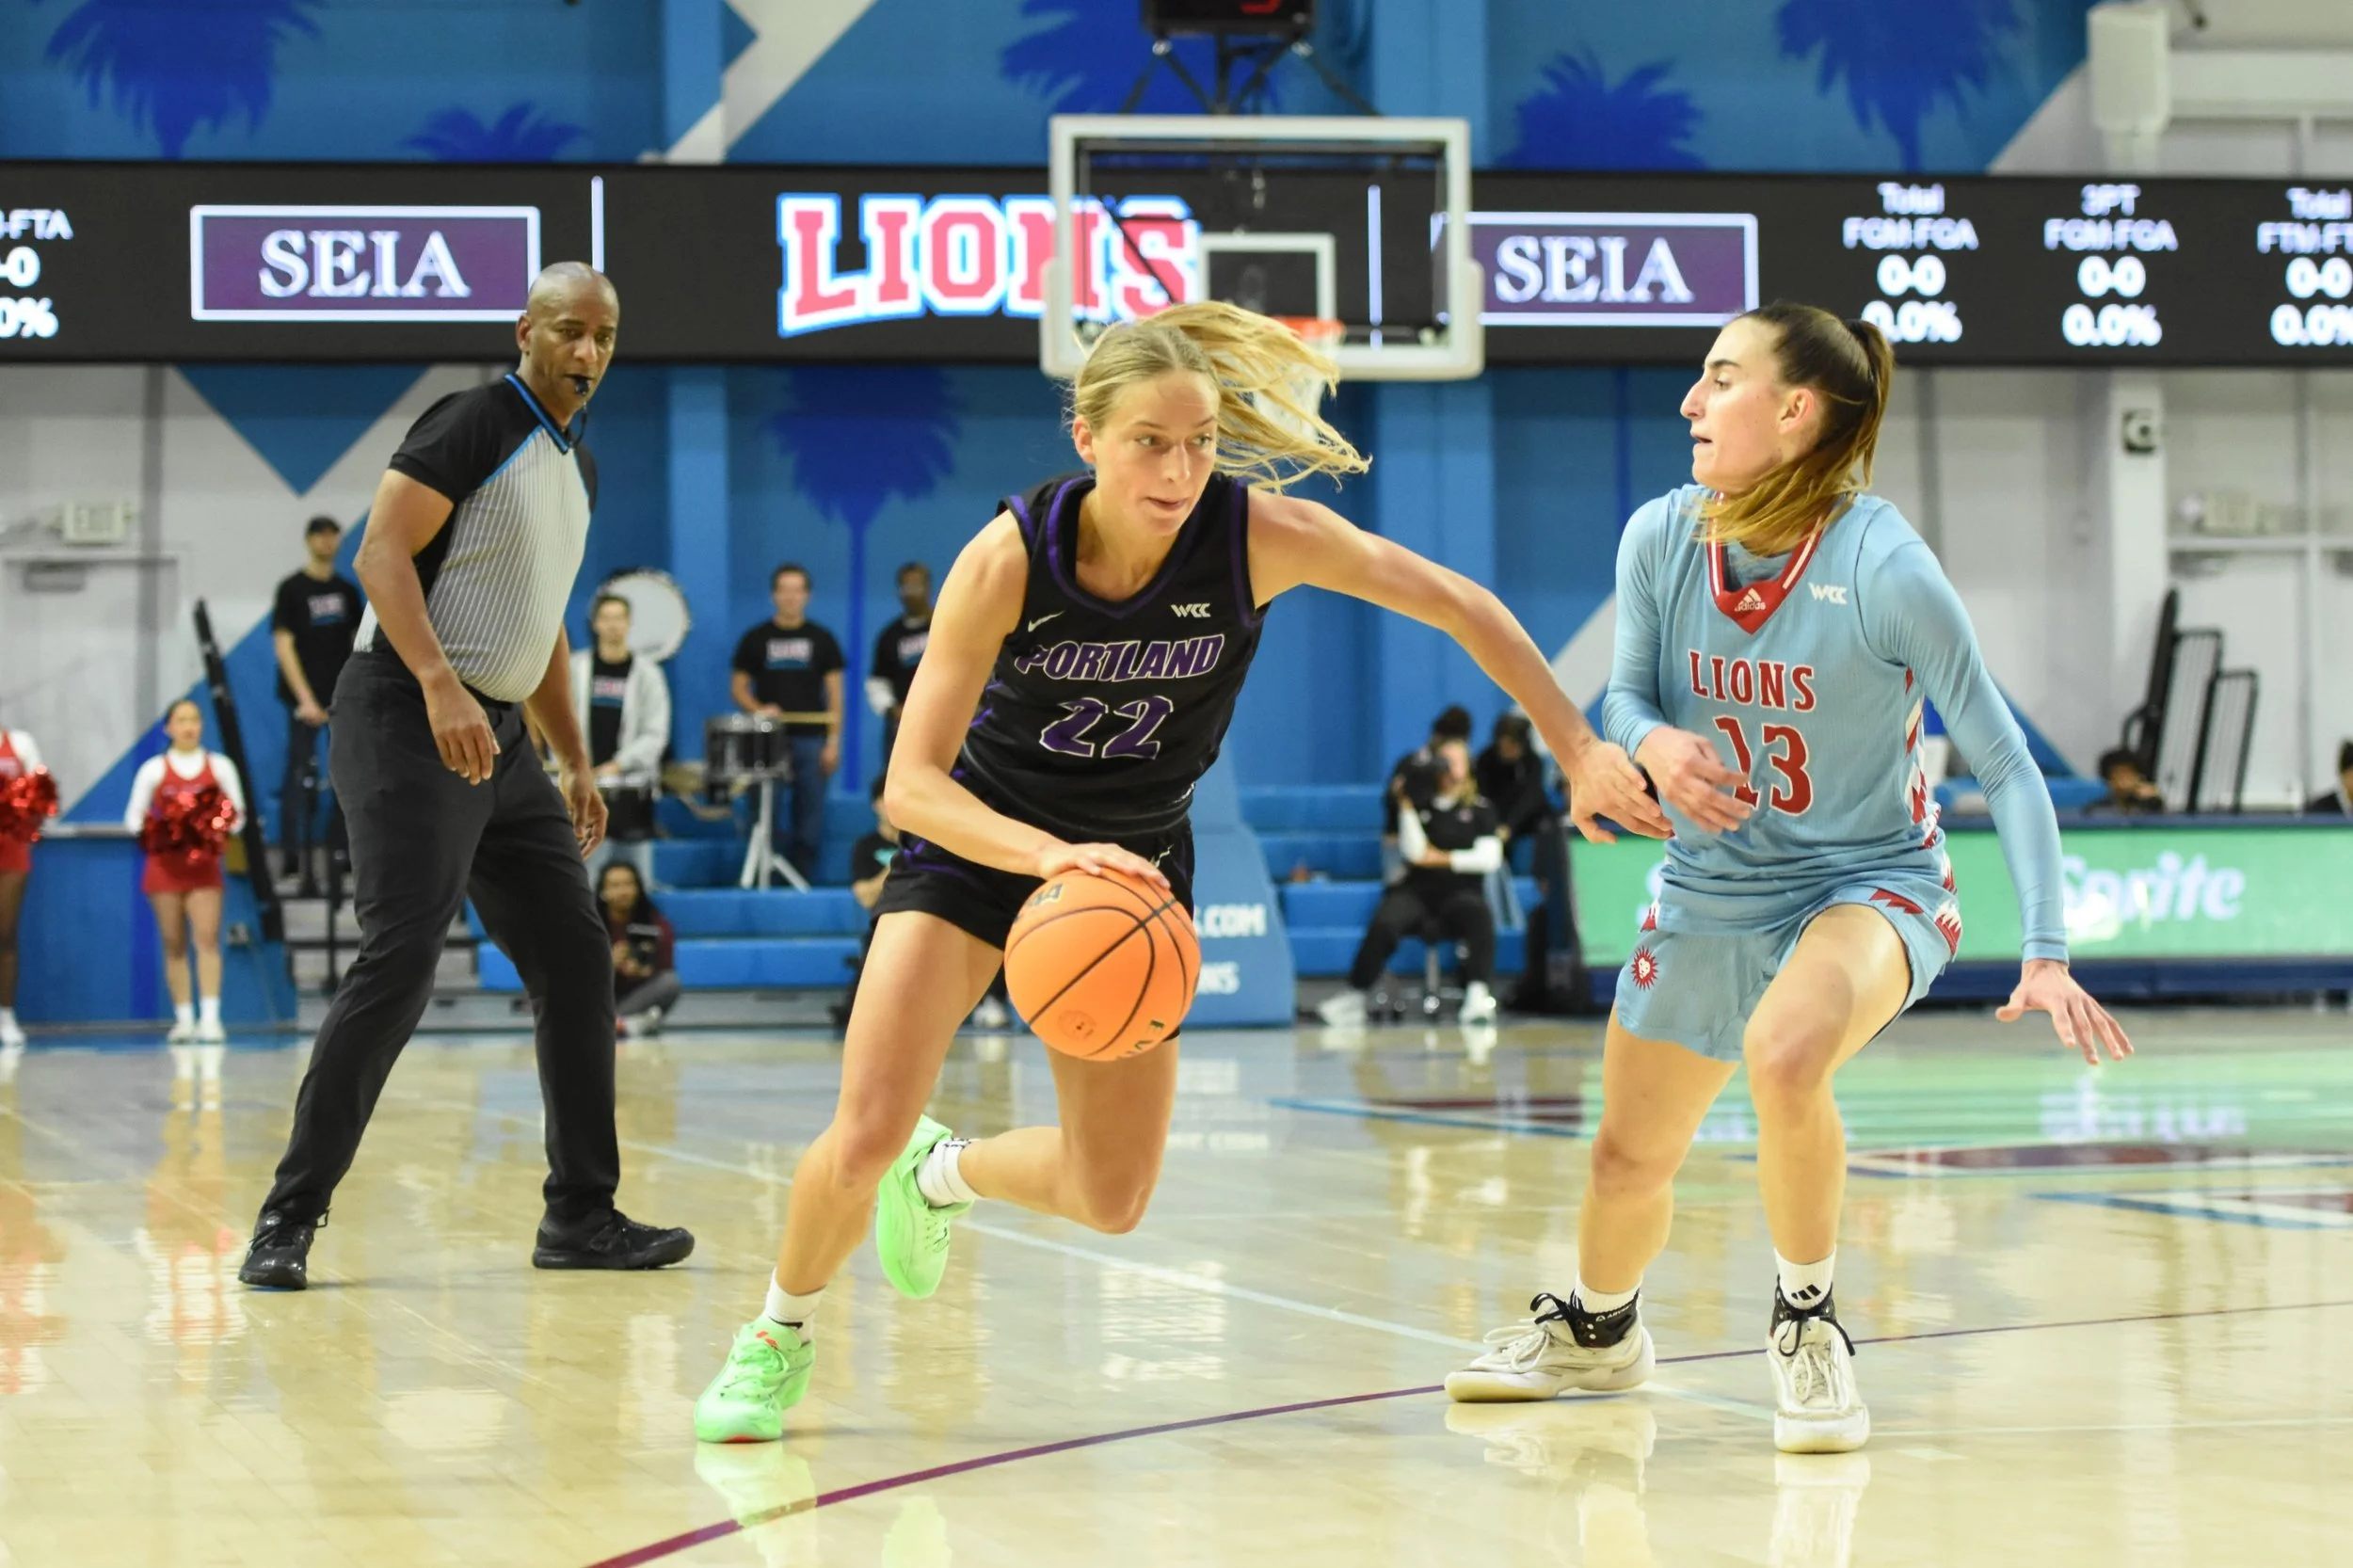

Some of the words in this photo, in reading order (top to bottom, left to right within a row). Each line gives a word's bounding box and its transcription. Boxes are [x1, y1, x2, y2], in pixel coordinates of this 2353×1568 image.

[1877, 183, 1945, 215] Total
[2081, 184, 2142, 216] 3PT
[258, 229, 472, 298] SEIA
[776, 193, 1203, 338] LIONS
[1495, 234, 1695, 303] SEIA
[1877, 254, 1946, 296] 0-0
[2077, 255, 2146, 297] 0-0
[2061, 303, 2163, 346] 0.0%
[1170, 602, 1211, 618] WCC
[1734, 599, 1767, 613] adidas
[1808, 582, 1848, 605] WCC
[1014, 632, 1225, 683] PORTLAND
[1688, 648, 1817, 713] LIONS
[1038, 695, 1174, 760] 22
[1712, 714, 1814, 816] 13
[2061, 849, 2246, 932] Sprite
